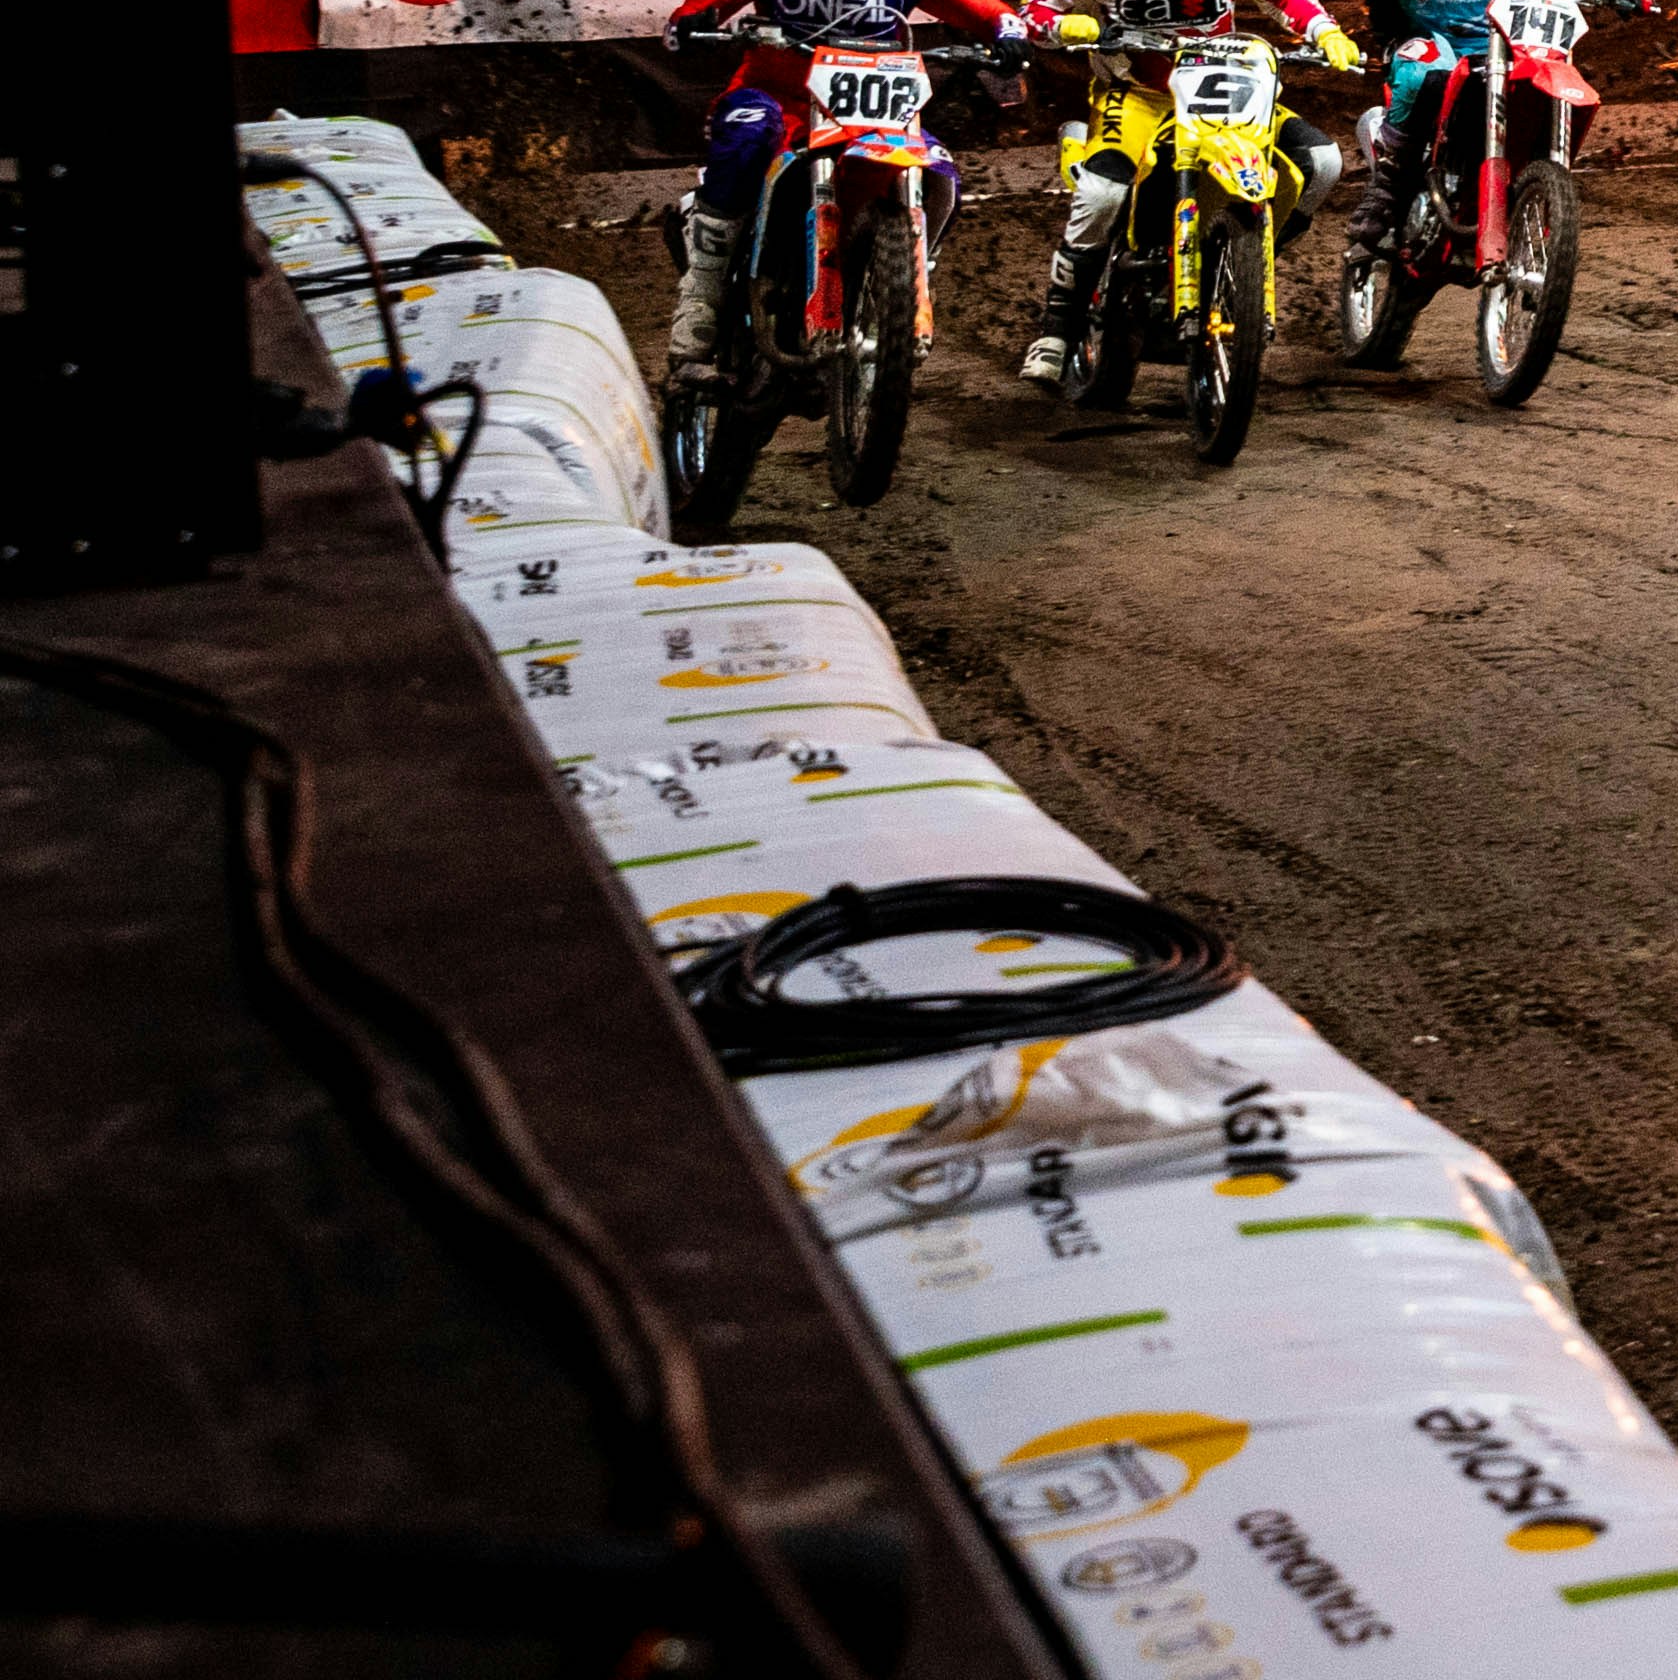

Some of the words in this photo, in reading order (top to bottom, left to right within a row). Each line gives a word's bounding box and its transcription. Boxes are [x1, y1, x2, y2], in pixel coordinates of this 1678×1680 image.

[1508, 4, 1577, 49] 141
[828, 70, 920, 122] 802
[1102, 88, 1127, 144] ZUKI
